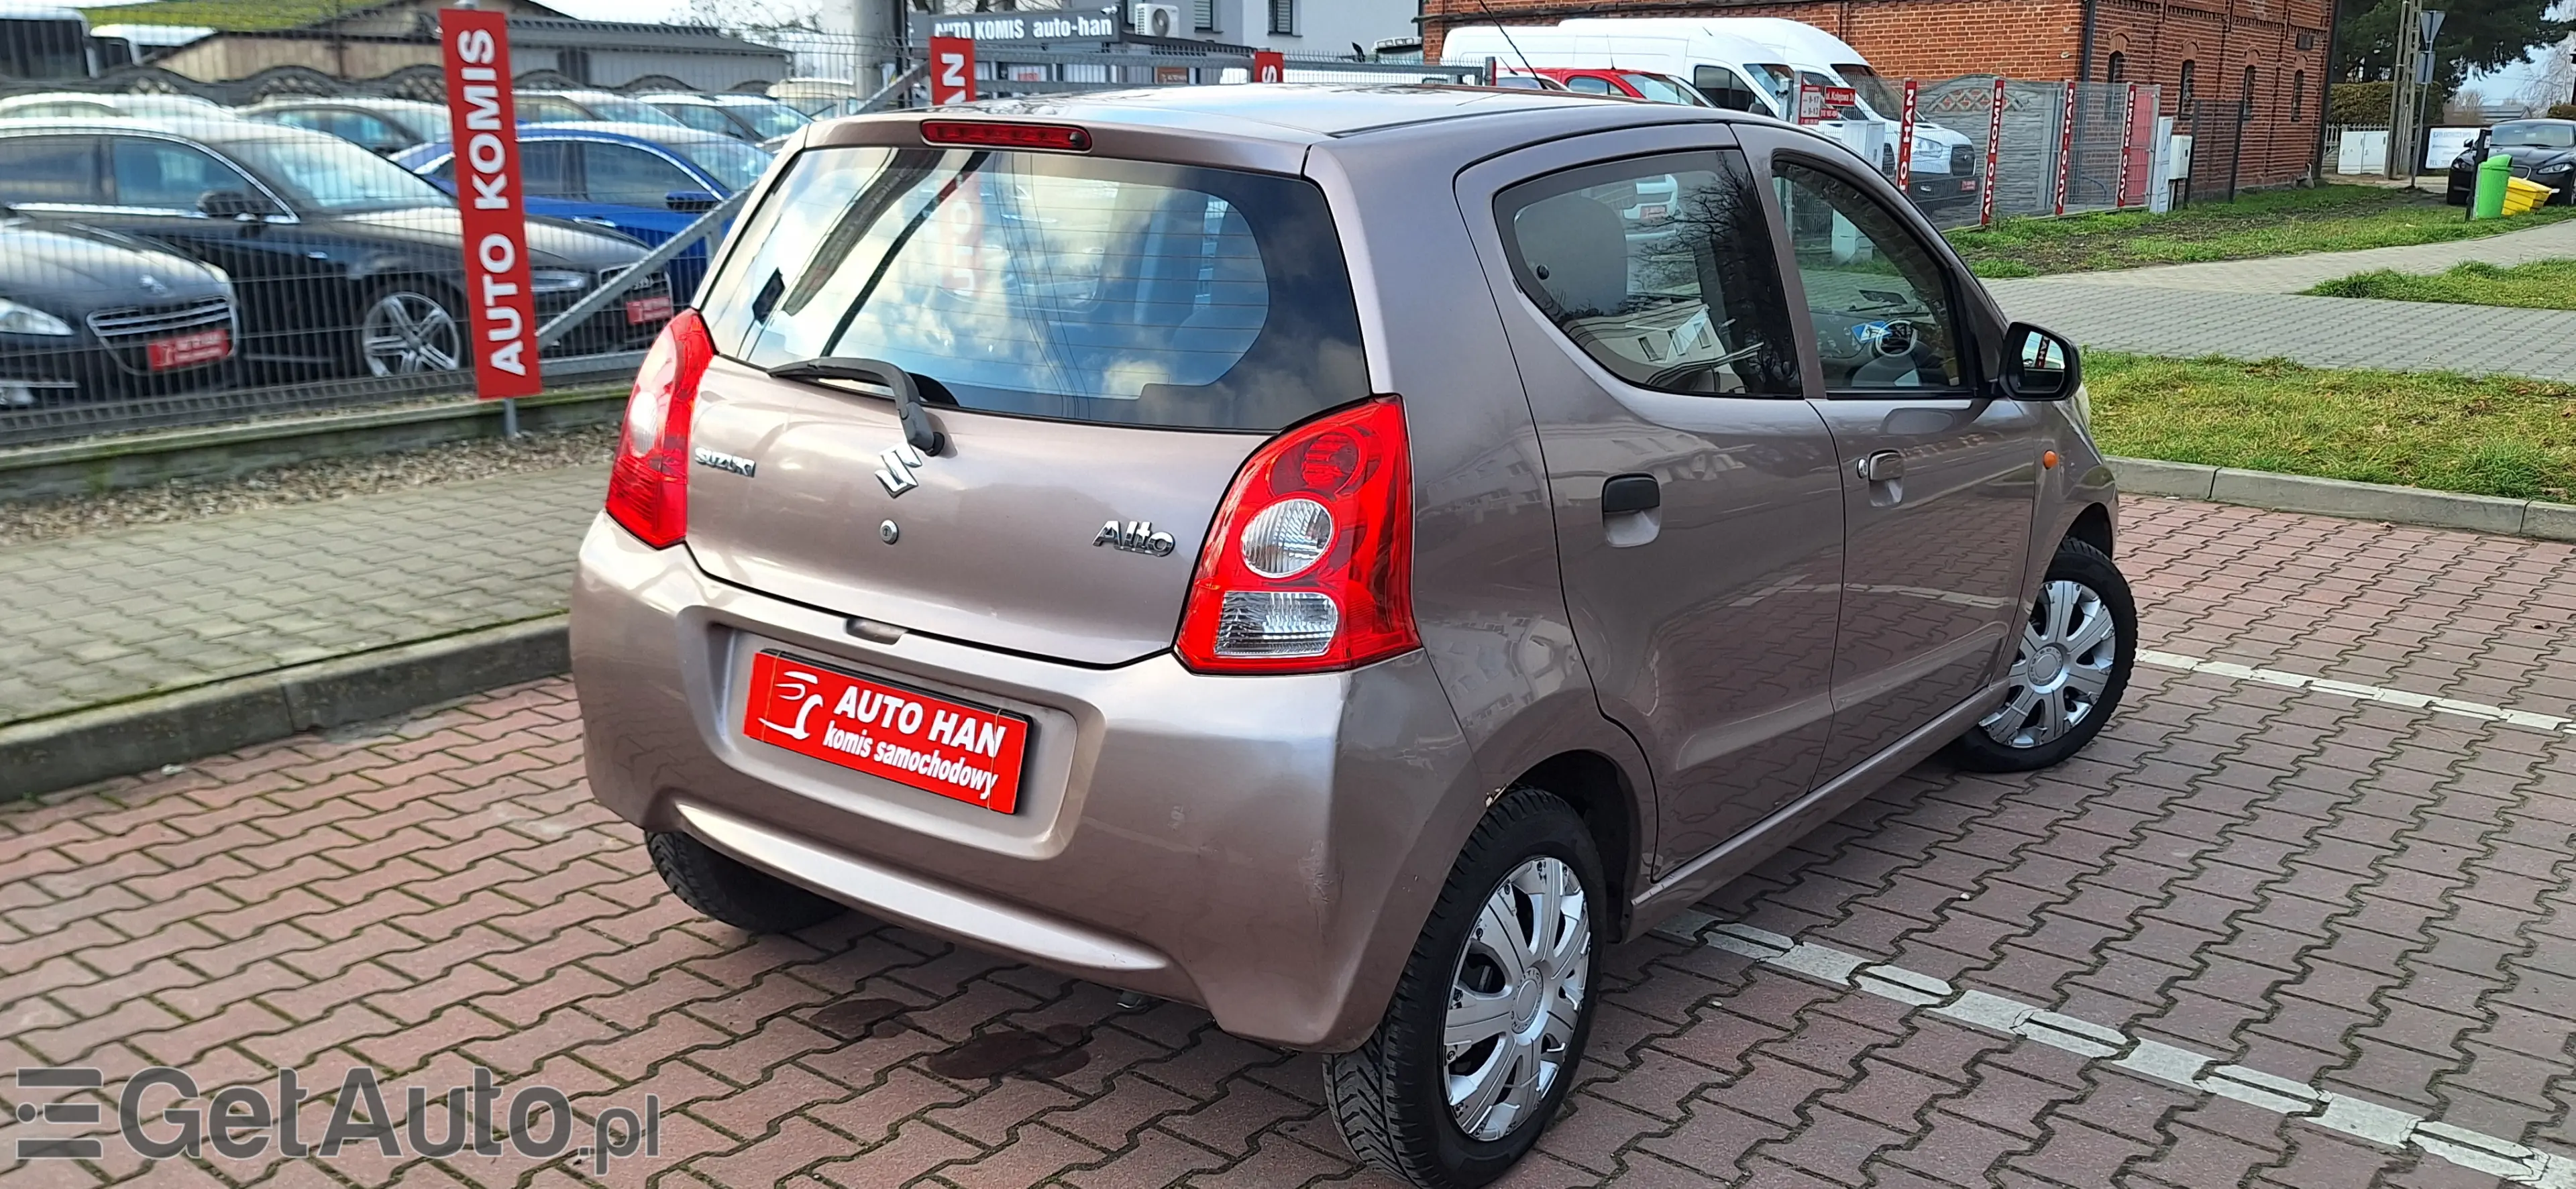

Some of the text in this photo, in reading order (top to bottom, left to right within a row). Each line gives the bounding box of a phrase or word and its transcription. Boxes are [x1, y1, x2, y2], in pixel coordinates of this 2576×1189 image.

[974, 19, 1024, 40] KOMIS
[1033, 17, 1113, 38] auto-han
[1984, 87, 2002, 215] AUTO KOMIS
[2118, 91, 2135, 201] AUTO KOMIS
[457, 29, 527, 376] AUTO KOMIS
[694, 447, 757, 478] SUZUKI
[1092, 520, 1176, 557] Alto
[834, 685, 1006, 758] AUTO HAN
[822, 720, 998, 800] komis samochodowy
